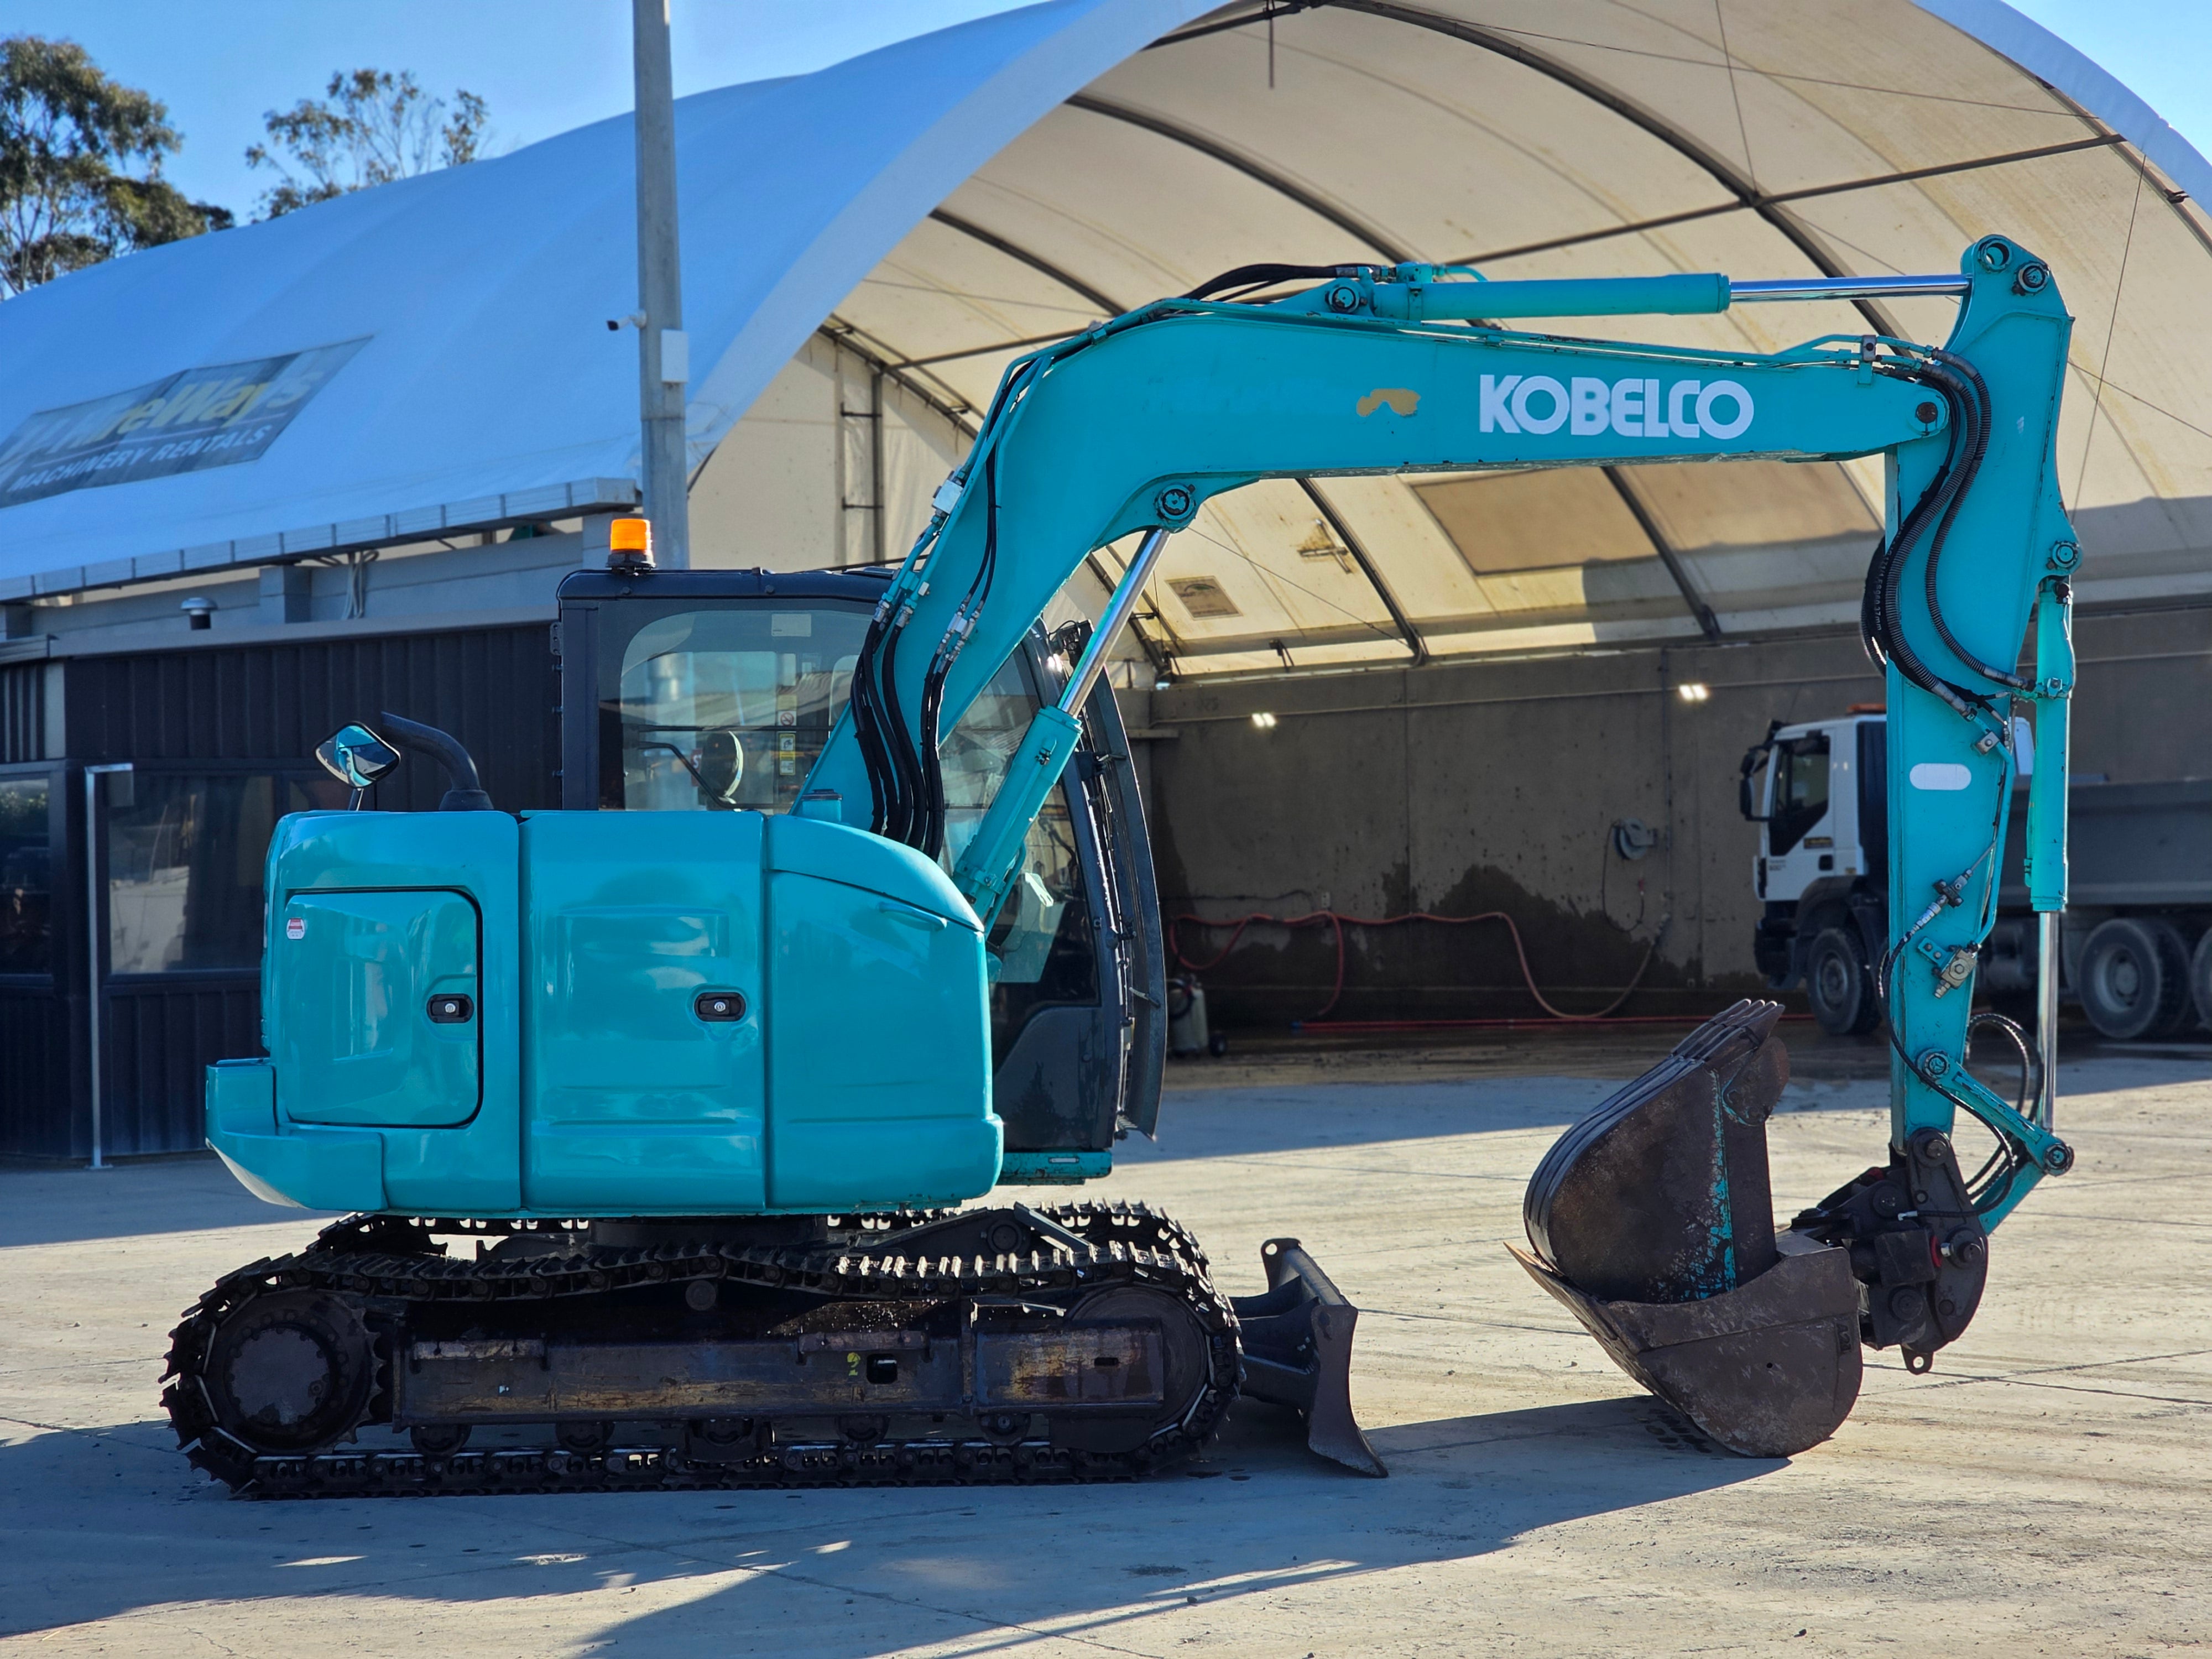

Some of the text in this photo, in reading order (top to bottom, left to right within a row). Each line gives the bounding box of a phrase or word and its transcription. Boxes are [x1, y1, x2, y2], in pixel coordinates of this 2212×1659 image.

[1479, 374, 1754, 440] KOBELCO
[7, 425, 273, 492] MACHINERY RENTALS
